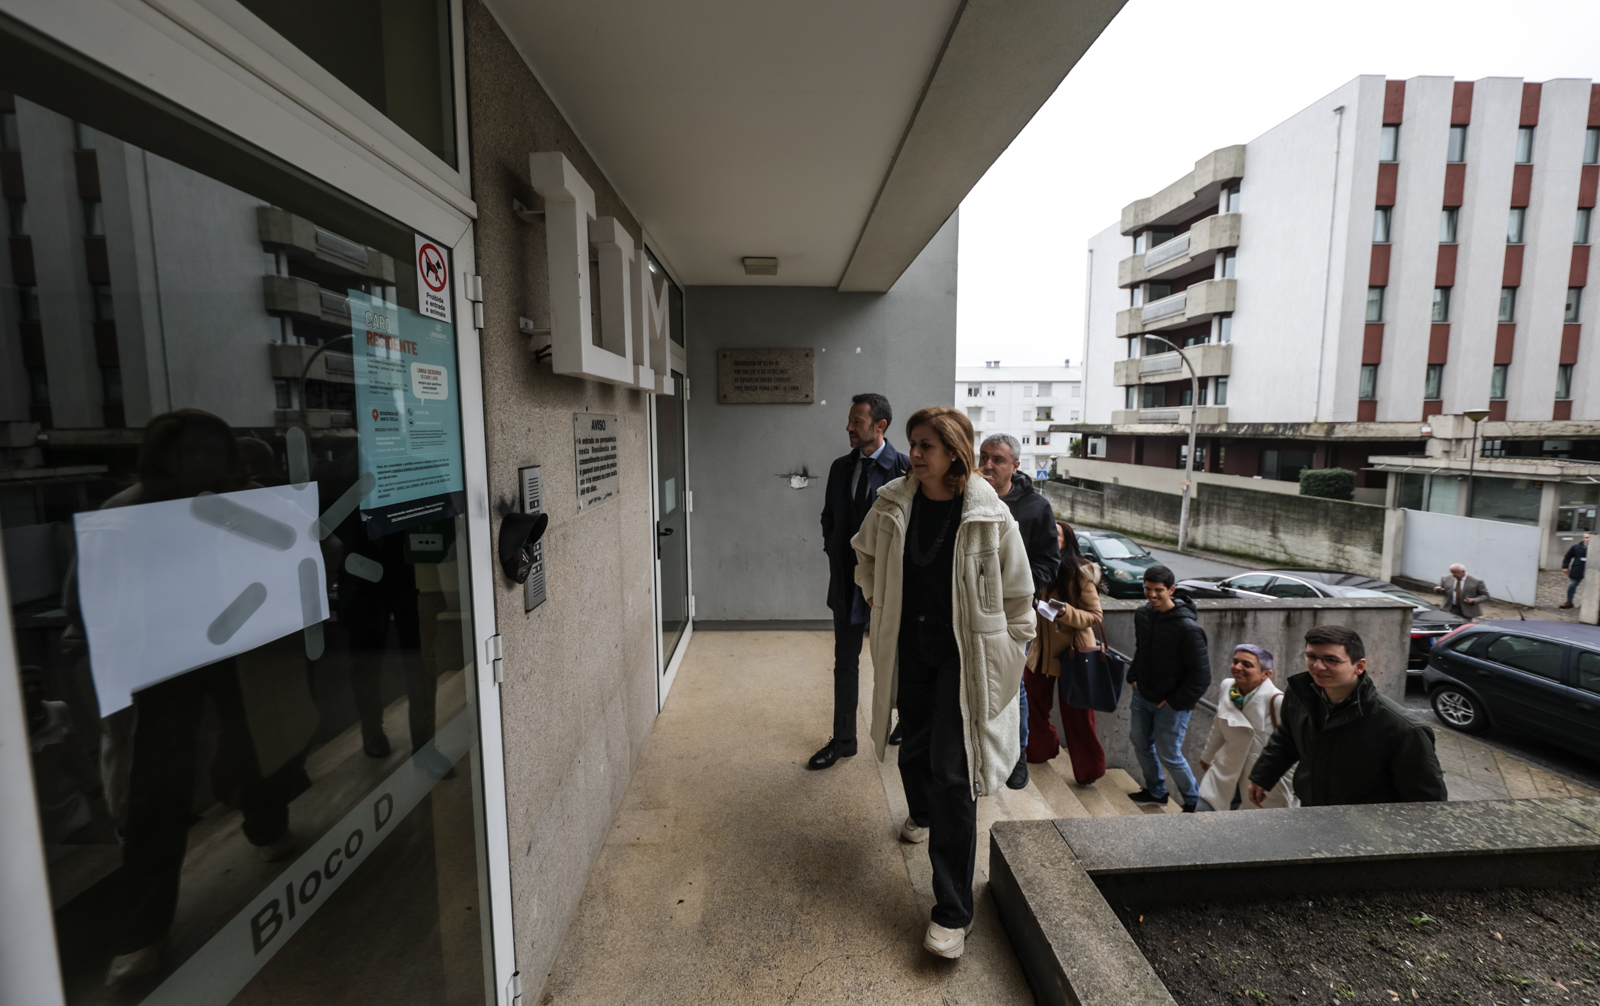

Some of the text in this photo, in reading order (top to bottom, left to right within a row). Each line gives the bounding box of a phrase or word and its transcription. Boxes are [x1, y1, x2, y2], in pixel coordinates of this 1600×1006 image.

[426, 292, 444, 304] Proibida
[430, 302, 446, 311] entrada
[430, 309, 446, 318] animais
[365, 310, 392, 333] CARO
[366, 330, 418, 356] RESIDENTE
[591, 419, 606, 431] AVISO
[250, 792, 394, 956] Bloco D
